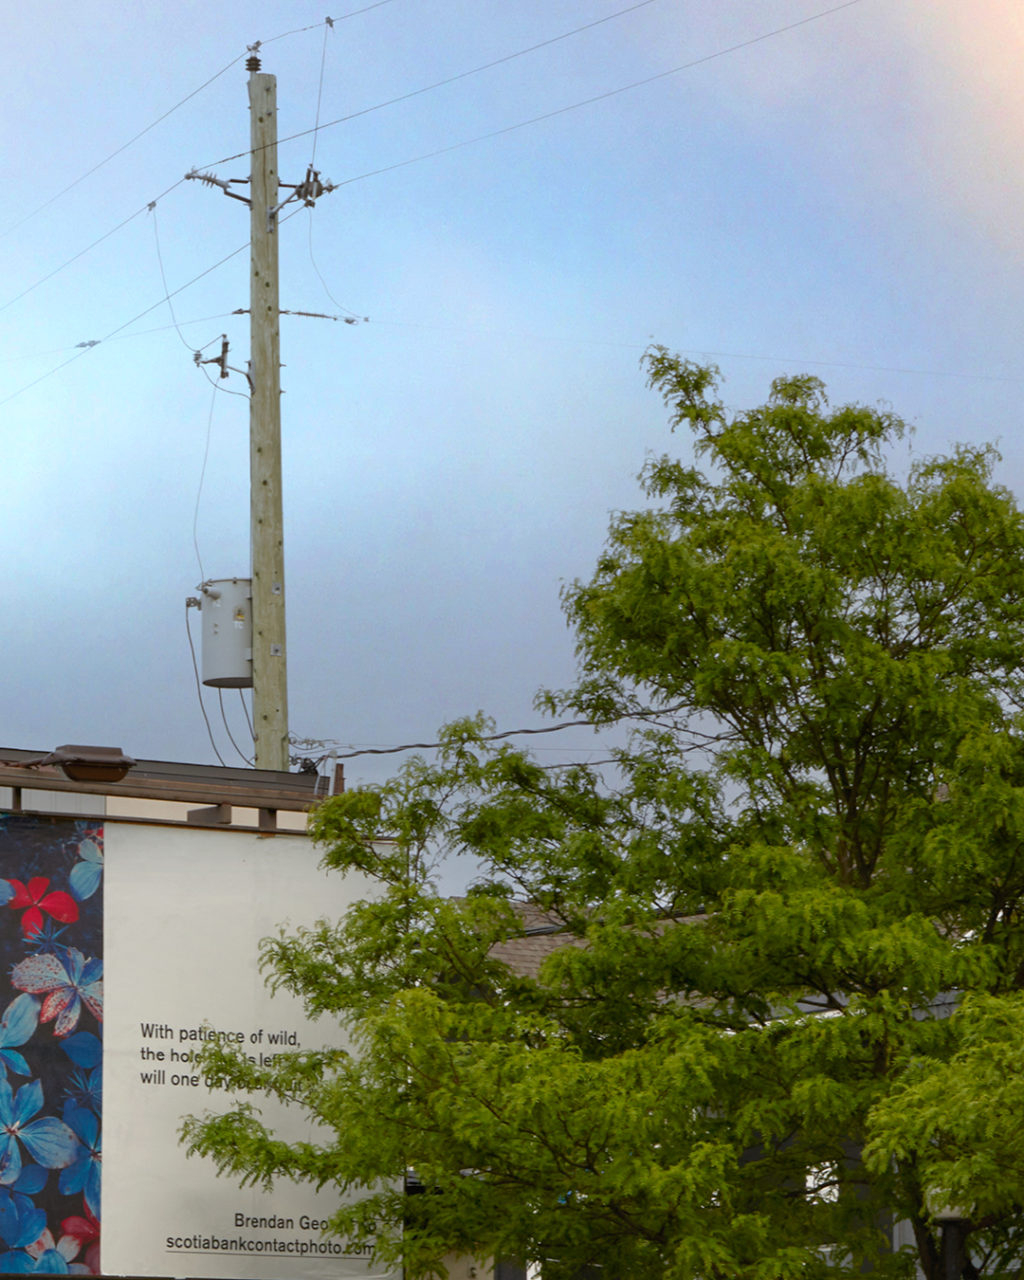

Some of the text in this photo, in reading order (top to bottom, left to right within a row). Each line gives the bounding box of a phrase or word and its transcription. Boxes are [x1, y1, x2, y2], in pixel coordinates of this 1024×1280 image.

[140, 1023, 301, 1048] With patience of wild,
[140, 1047, 165, 1061] the
[140, 1070, 165, 1085] will
[170, 1074, 199, 1087] one
[234, 1213, 294, 1230] Brendan
